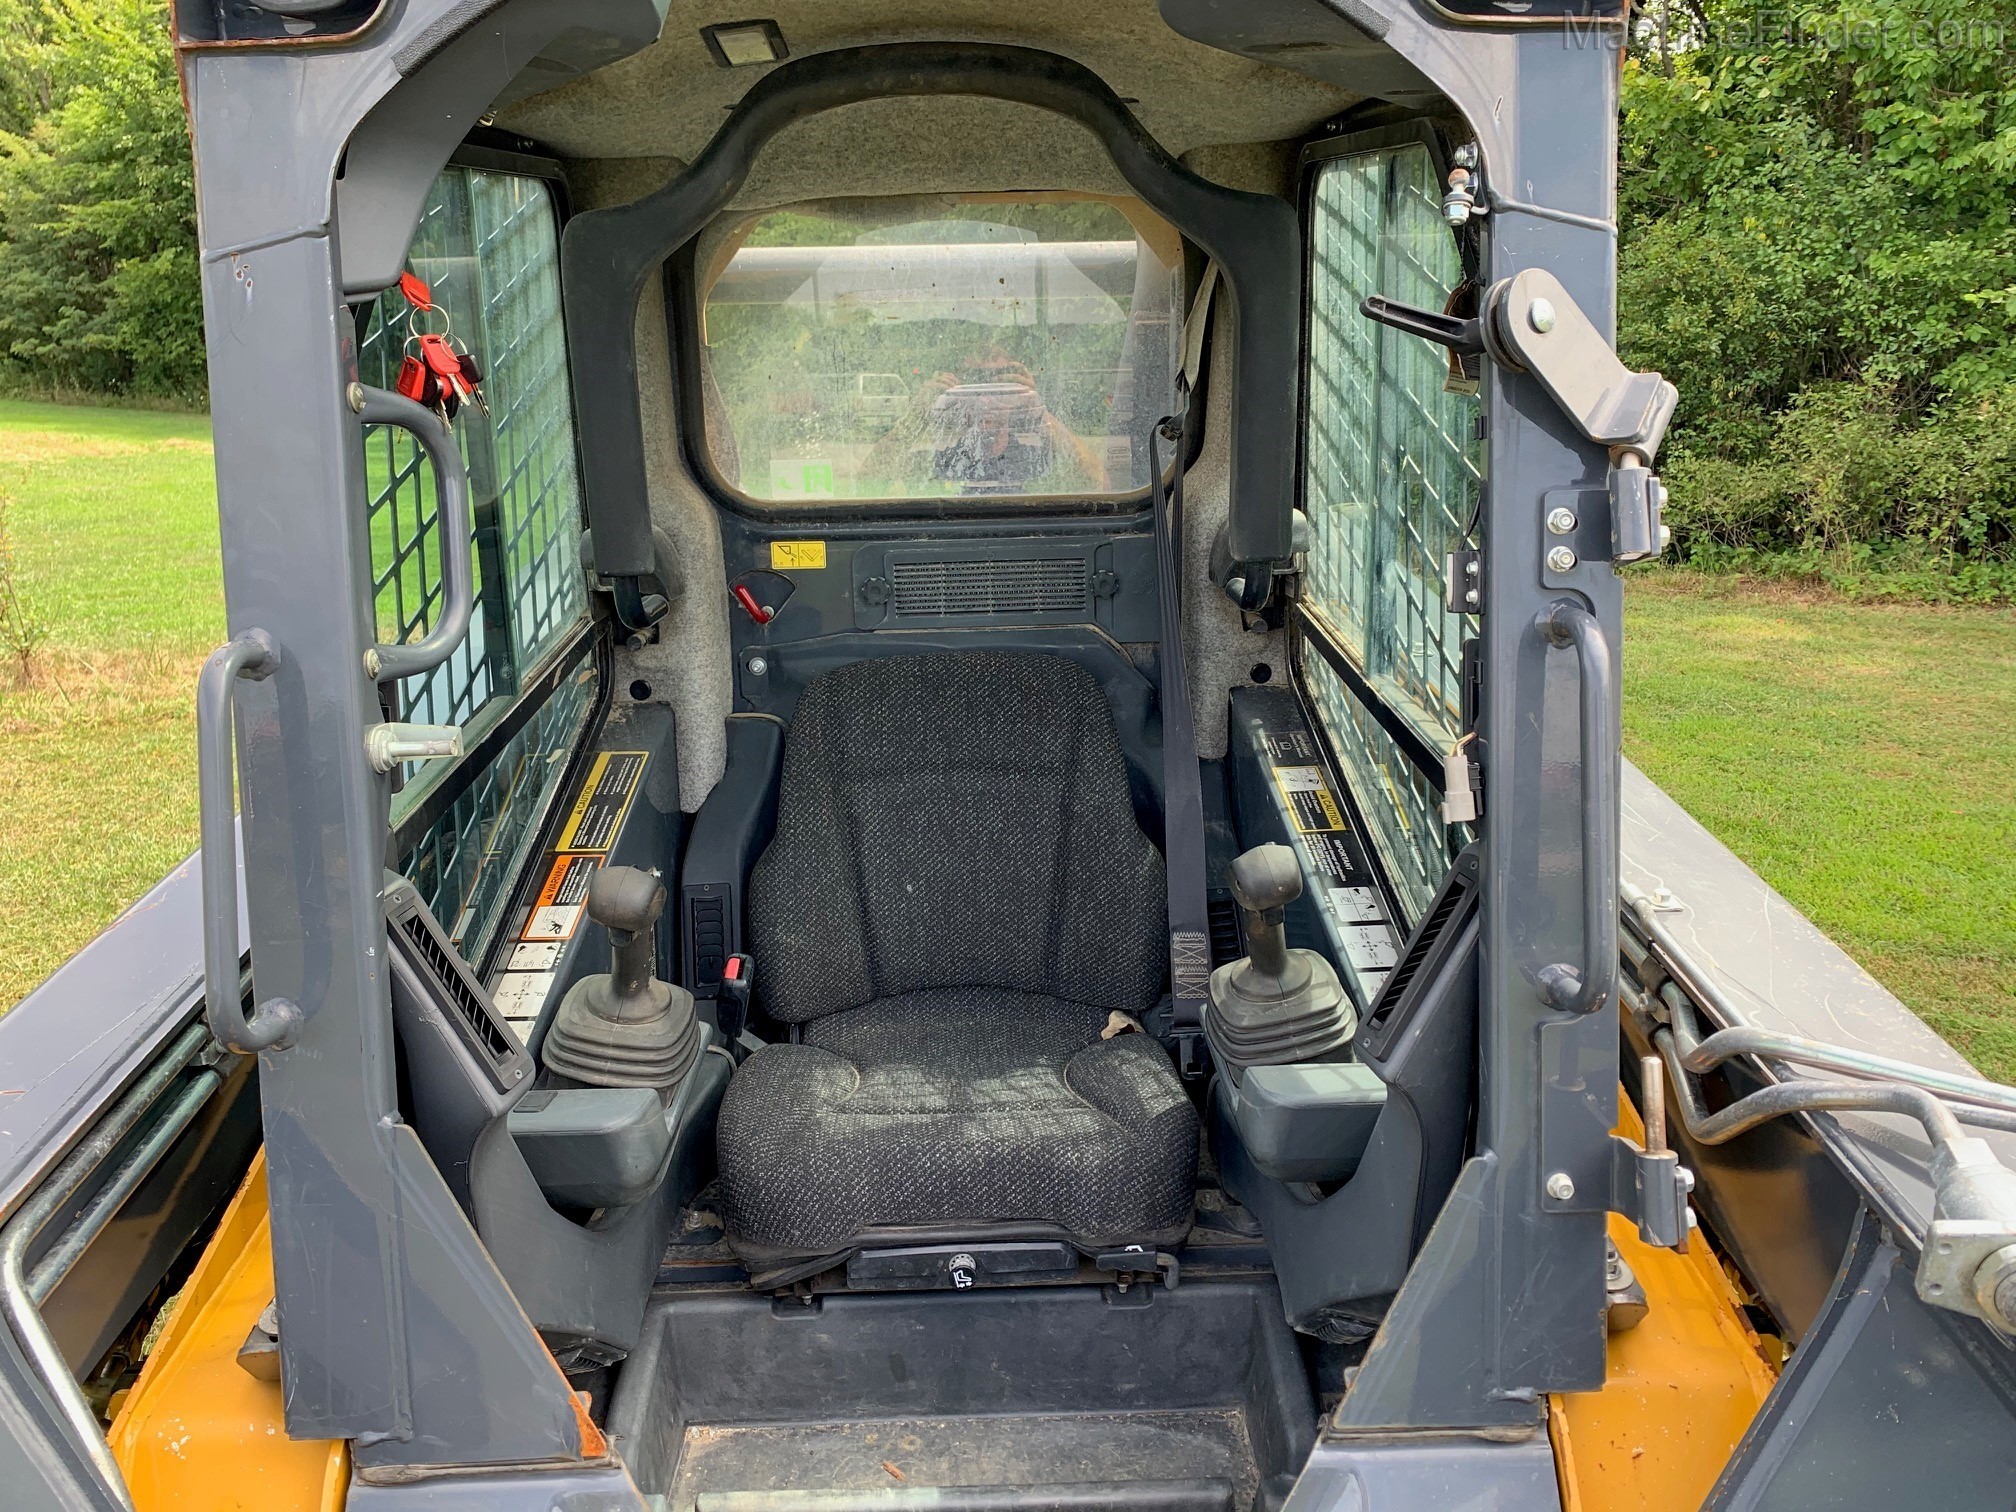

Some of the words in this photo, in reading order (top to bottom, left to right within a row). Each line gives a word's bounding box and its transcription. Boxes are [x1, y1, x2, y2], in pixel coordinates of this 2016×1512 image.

[576, 784, 594, 808] CAUTION
[1323, 800, 1340, 825] CAUTION
[1333, 839, 1353, 870] IMPORTANT
[548, 864, 566, 891] WARNING
